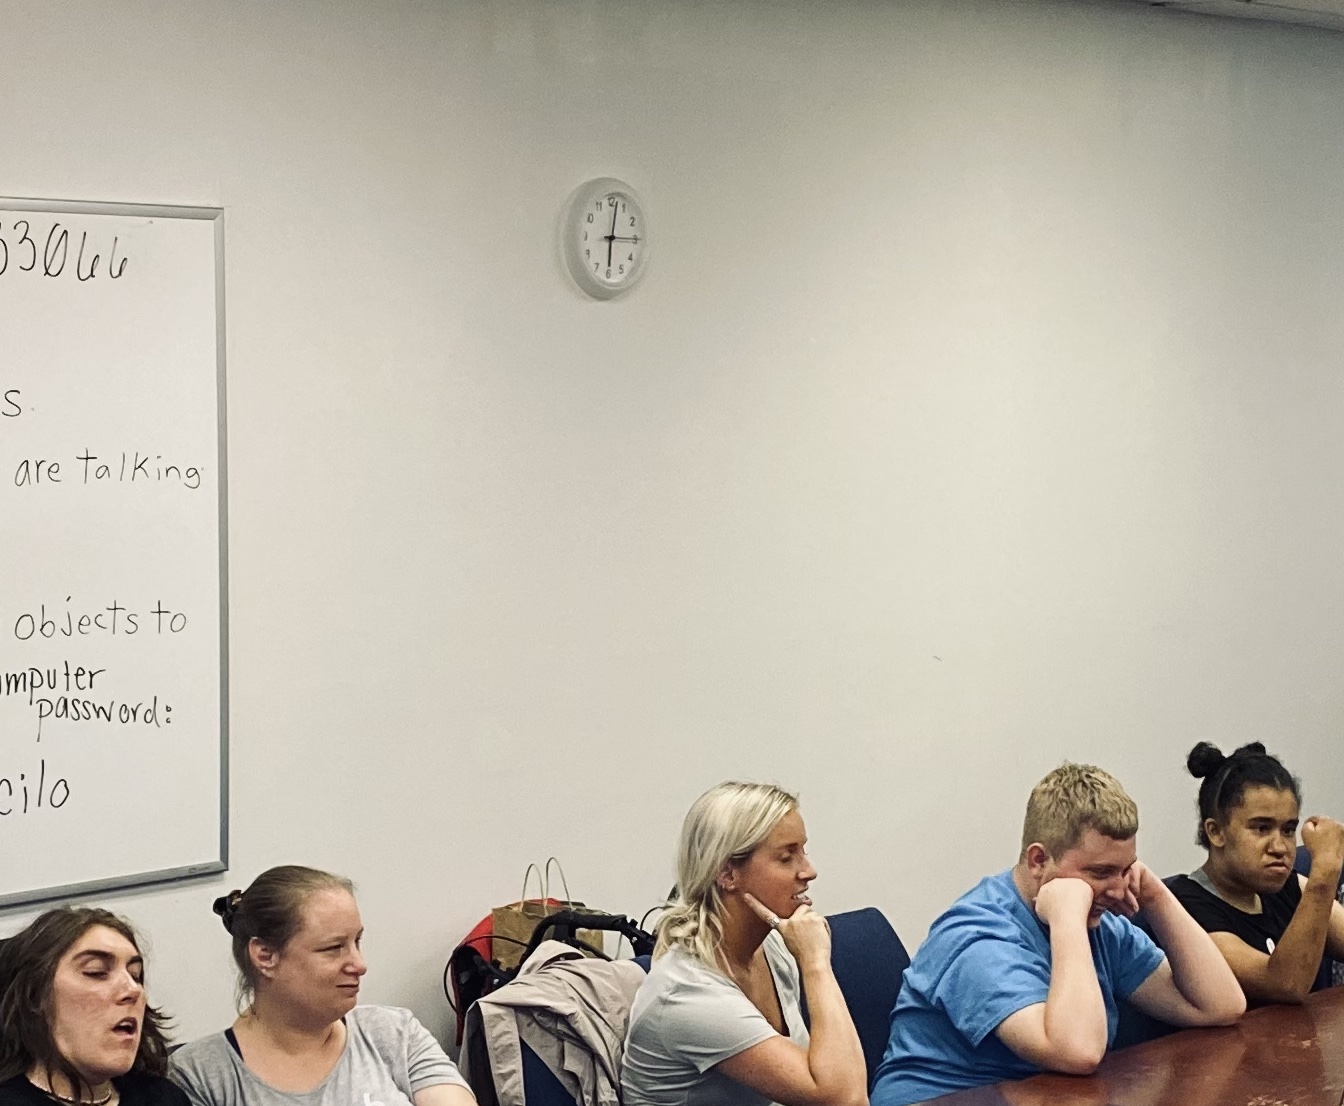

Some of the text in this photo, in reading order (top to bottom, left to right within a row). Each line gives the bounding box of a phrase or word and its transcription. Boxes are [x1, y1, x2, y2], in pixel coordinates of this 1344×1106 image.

[15, 460, 62, 487] are
[15, 596, 138, 640] objects
[150, 600, 186, 634] to
[36, 695, 172, 742] password:
